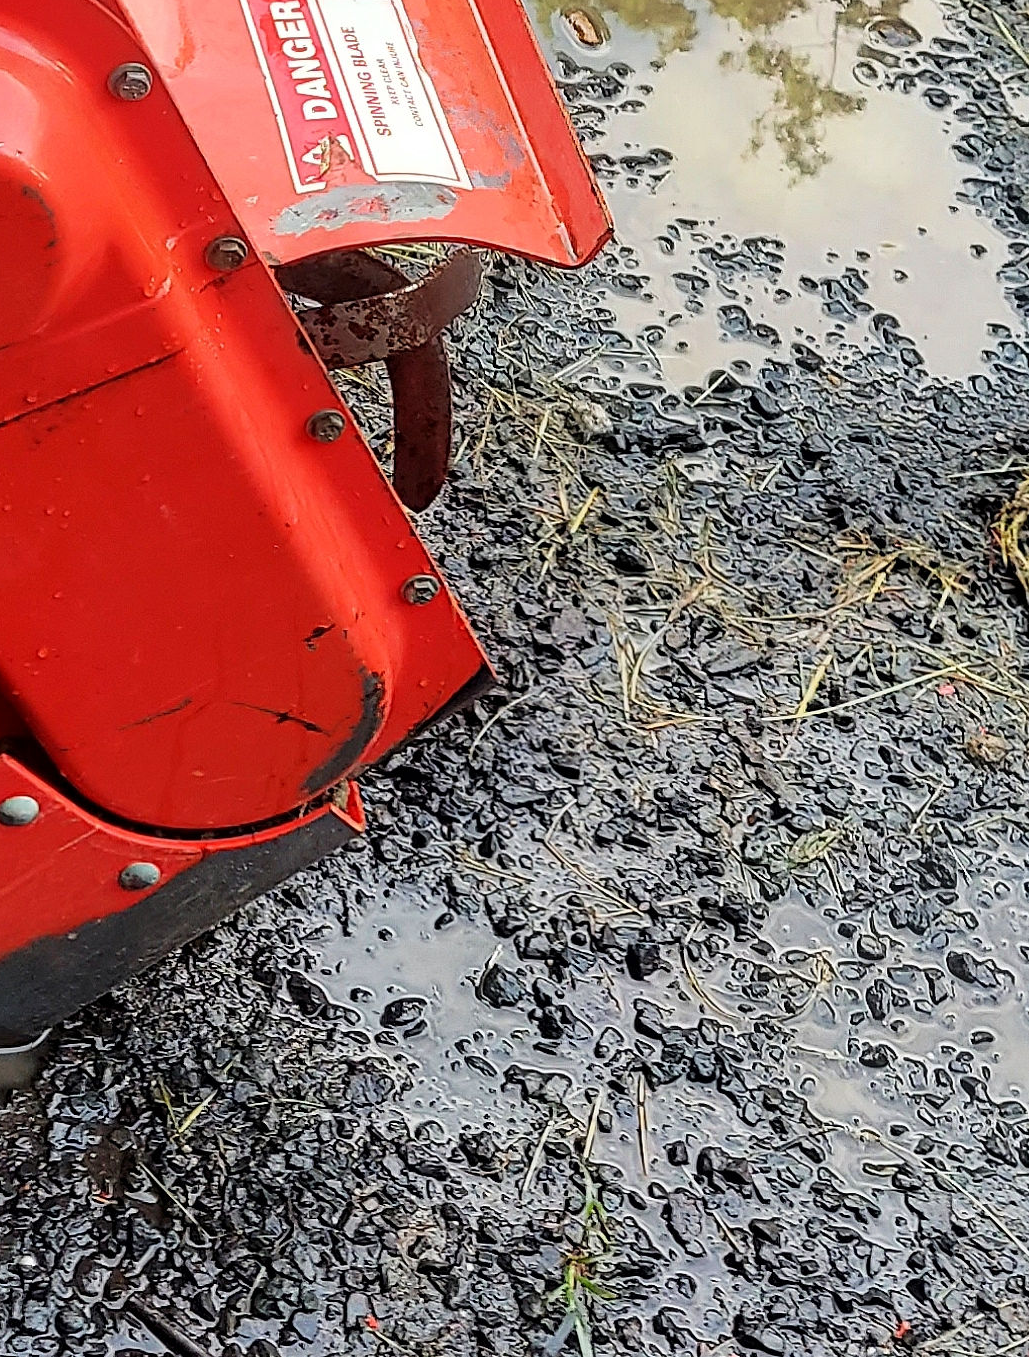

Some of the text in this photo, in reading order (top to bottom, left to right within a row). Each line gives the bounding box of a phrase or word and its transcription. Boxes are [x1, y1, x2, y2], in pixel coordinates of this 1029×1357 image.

[269, 0, 338, 121] DANGER
[340, 26, 392, 137] SPINNING BLADE
[376, 58, 400, 105] KEEP CLEAR
[385, 41, 424, 127] CONTACT CAN INJURE
